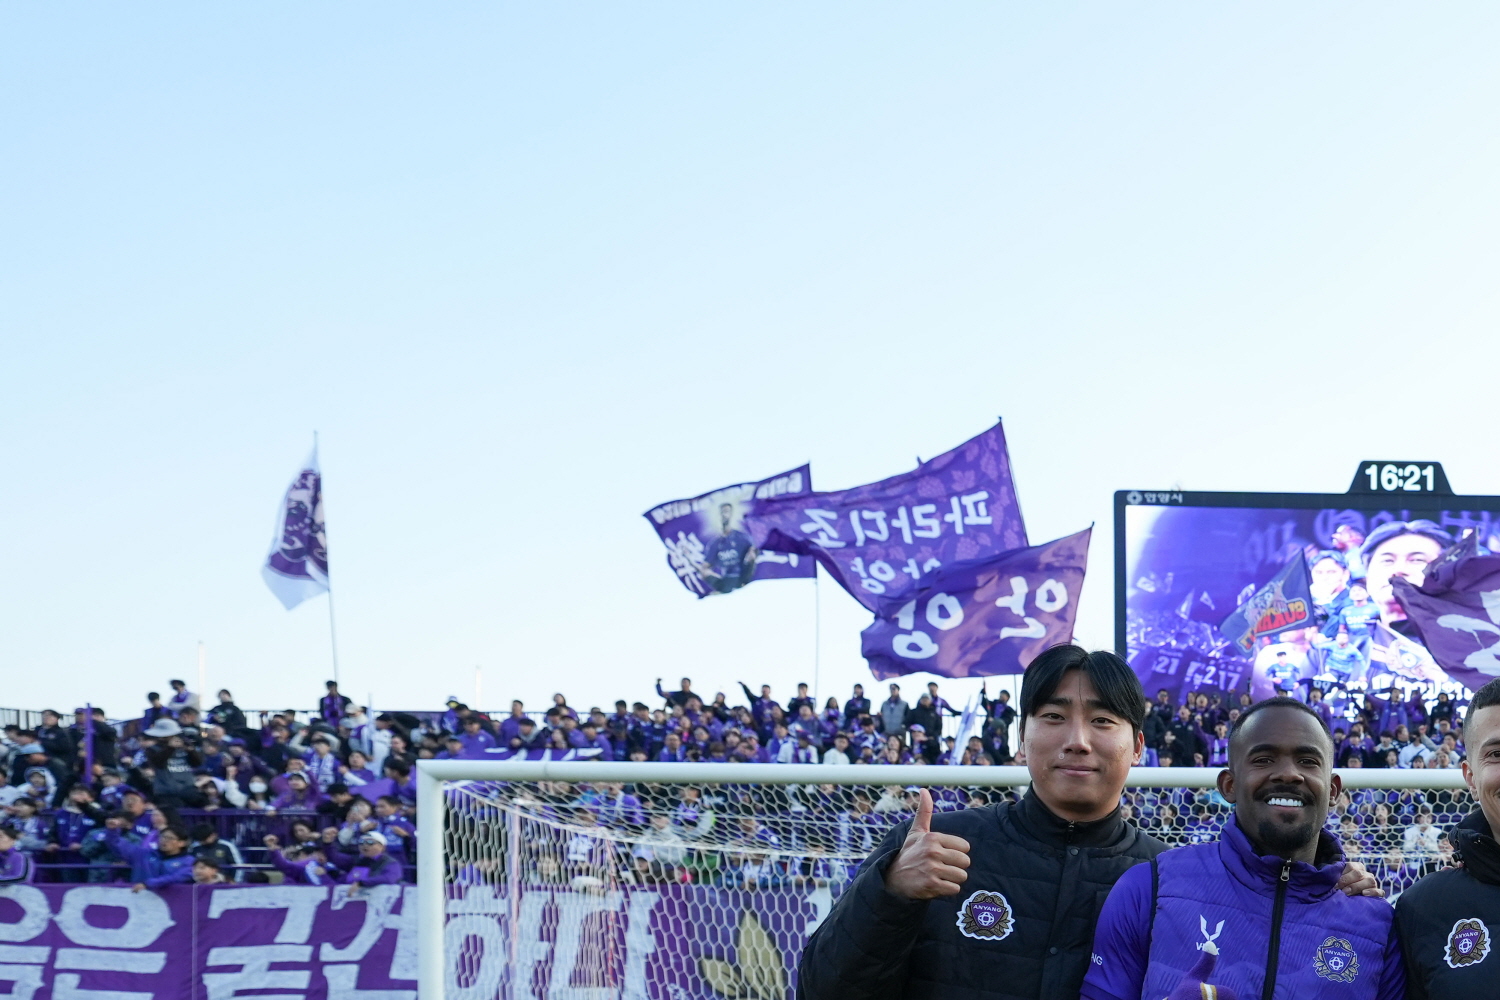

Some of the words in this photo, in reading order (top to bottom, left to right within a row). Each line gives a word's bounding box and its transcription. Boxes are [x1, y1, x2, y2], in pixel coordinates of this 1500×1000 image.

[1365, 464, 1434, 491] 16:21
[973, 904, 1002, 913] ANYANG
[1454, 931, 1479, 940] ANYANG
[1324, 949, 1351, 957] ANYANG
